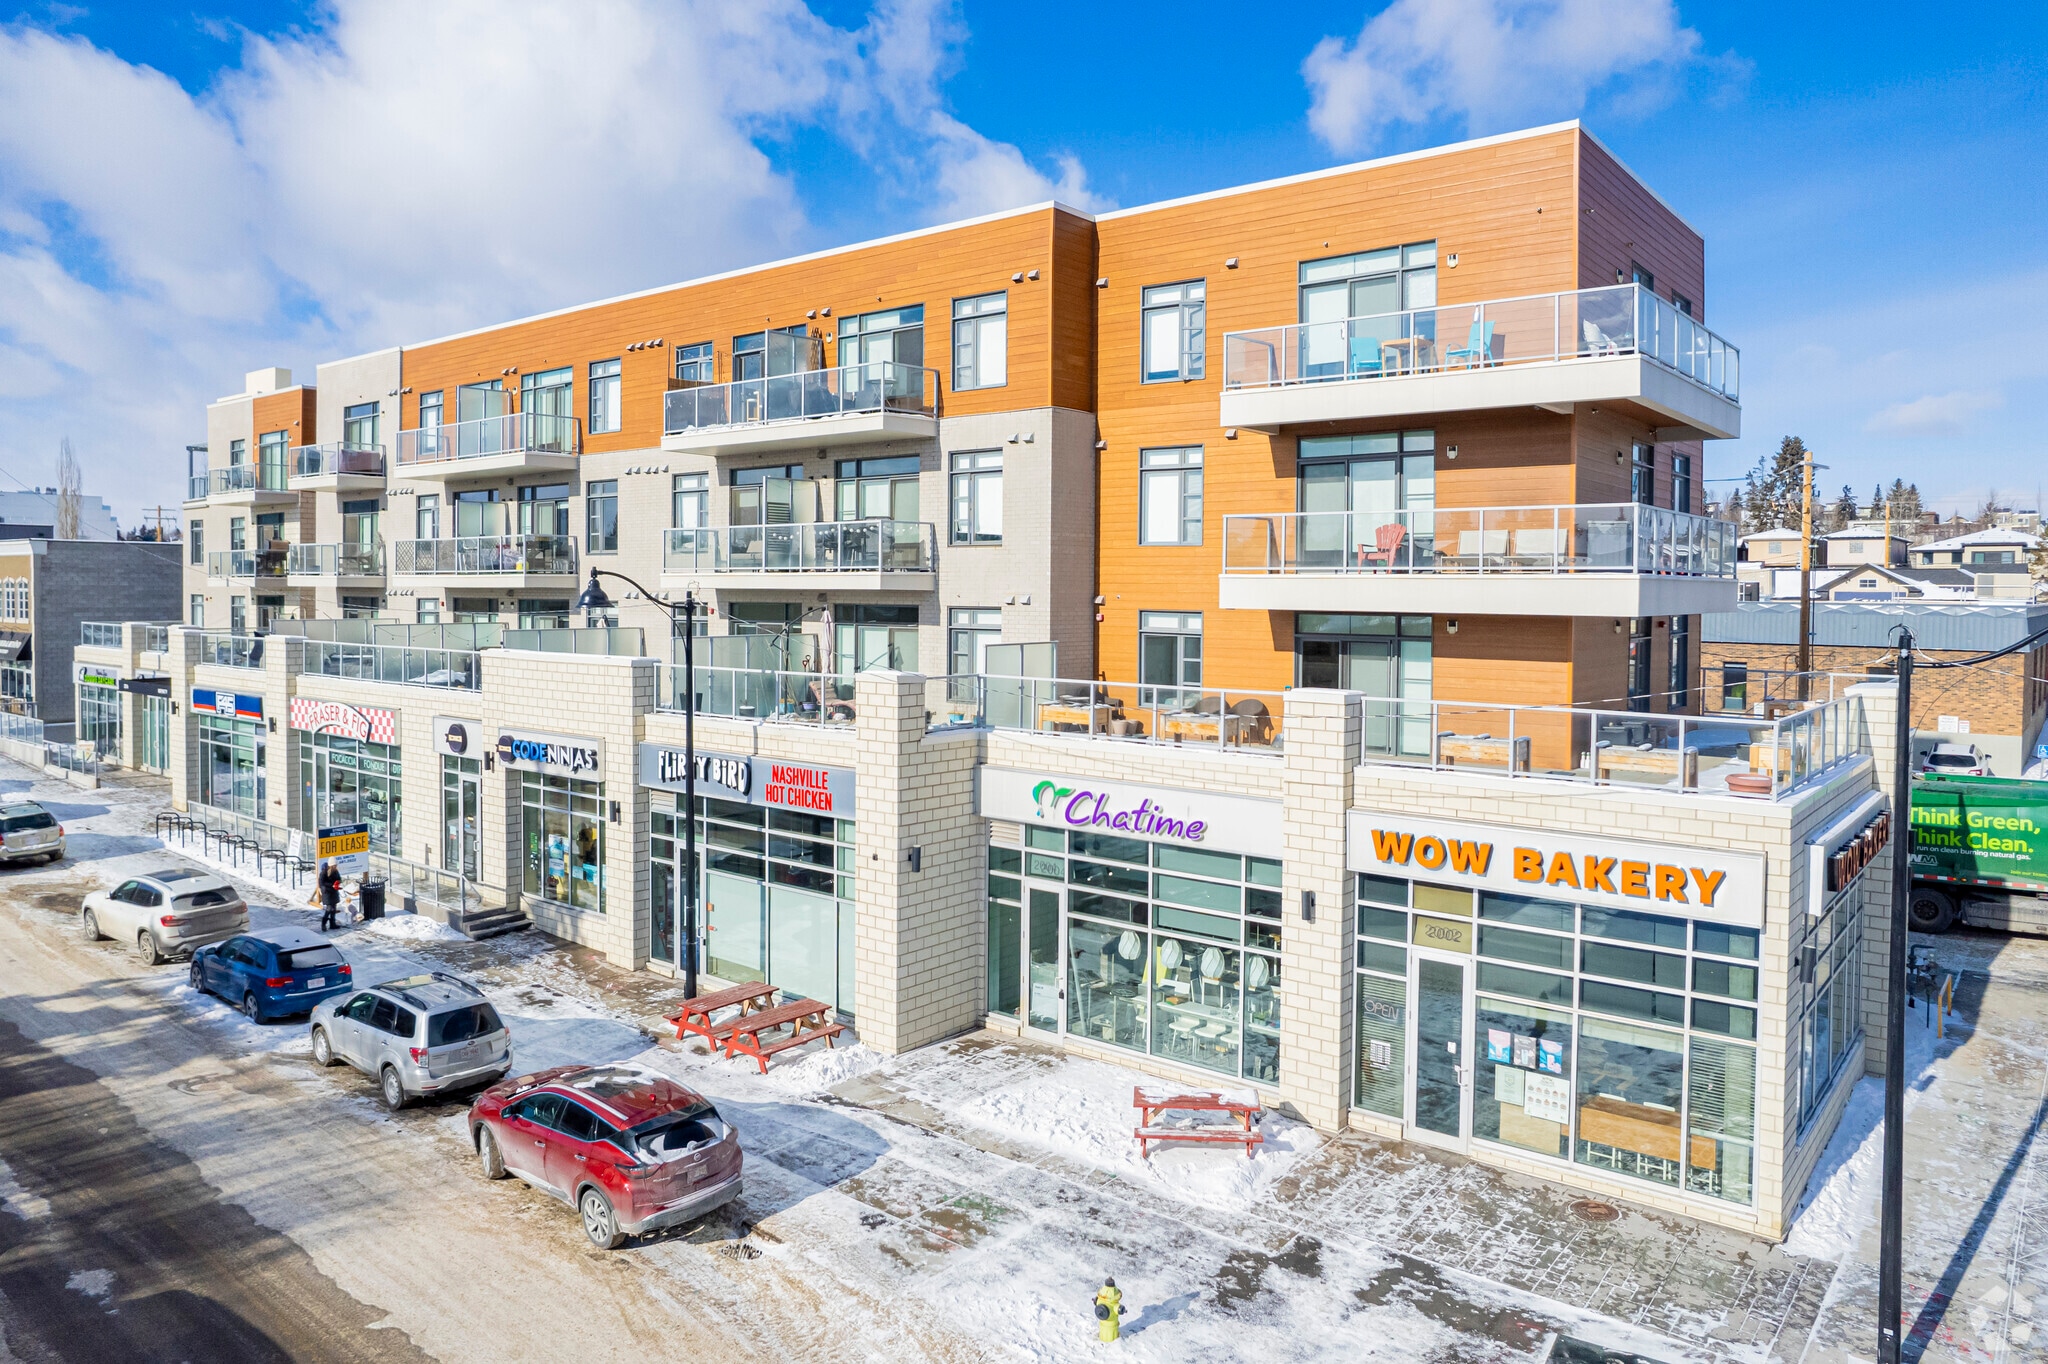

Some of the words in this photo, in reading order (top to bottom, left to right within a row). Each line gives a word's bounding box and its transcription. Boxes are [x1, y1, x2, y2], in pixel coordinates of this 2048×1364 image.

[309, 705, 340, 731] FRASER
[342, 708, 350, 724] &
[351, 713, 367, 738] FIG
[363, 759, 385, 772] FONDUE
[771, 765, 828, 790] NASHVILLE
[765, 784, 785, 804] HOT
[787, 787, 832, 811] CHICKEN
[1064, 790, 1204, 840] Chatime
[1967, 811, 2041, 835] Green,
[320, 840, 337, 855] FOR
[340, 835, 367, 852] LEASE
[1917, 828, 1962, 847] hink
[1966, 833, 2034, 854] Clean.
[1960, 848, 1988, 858] burning
[1989, 851, 2015, 859] natural
[1371, 829, 1493, 876] WOW
[1513, 847, 1726, 906] BAKERY
[1425, 924, 1463, 942] 2002
[1364, 1000, 1399, 1020] OPEN
